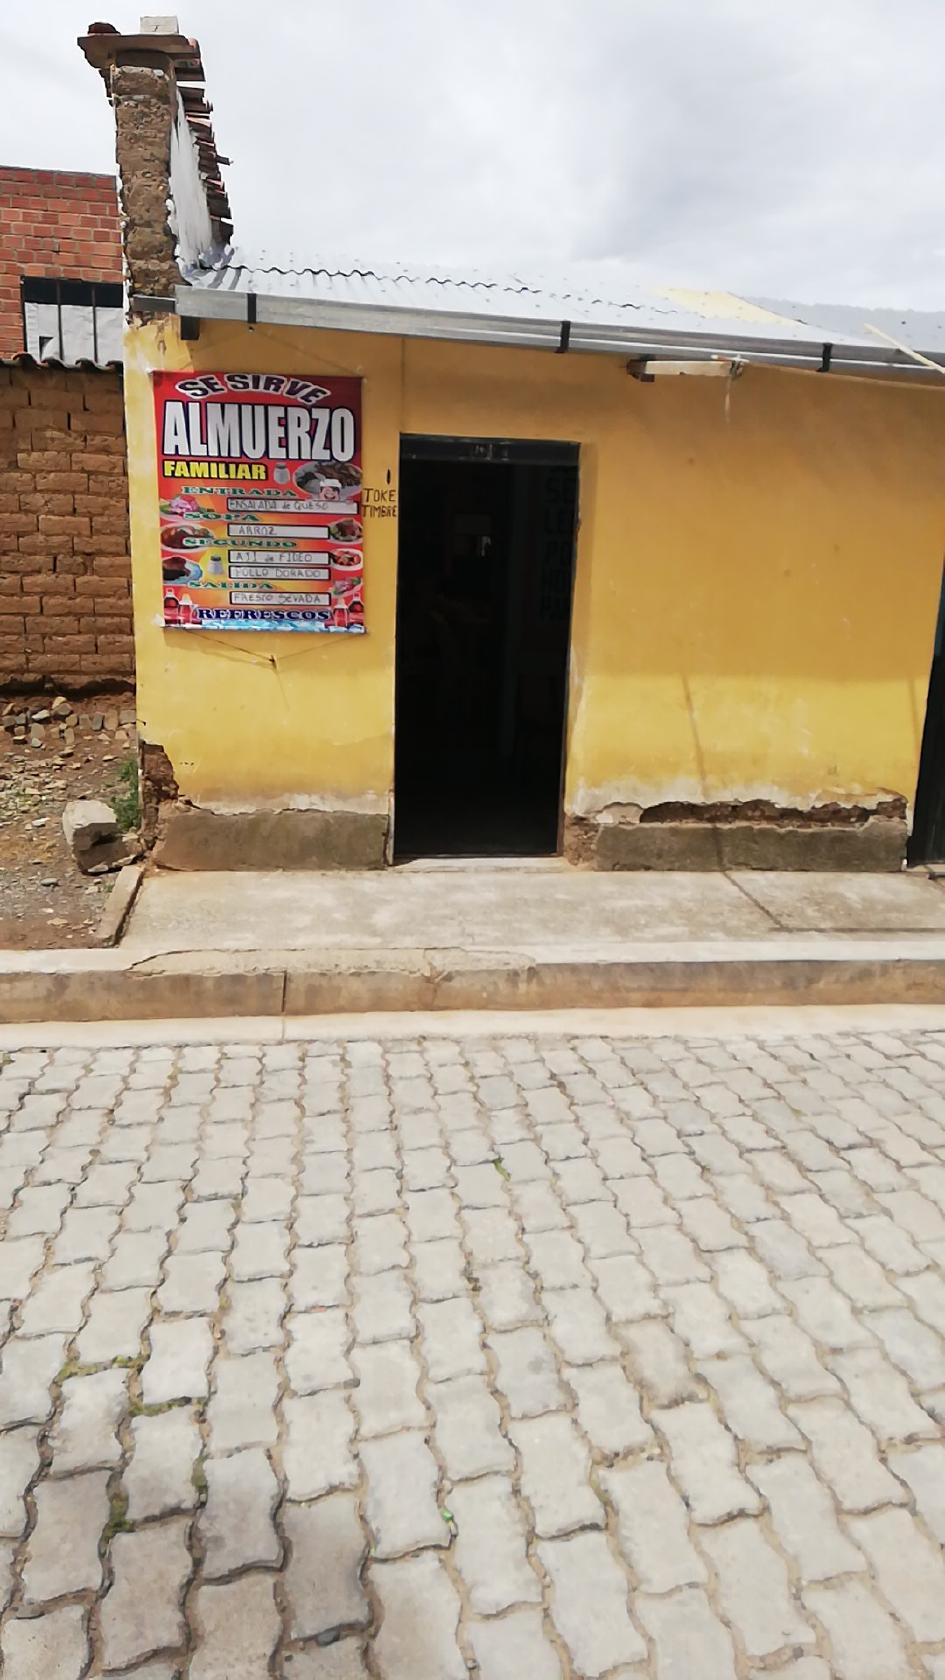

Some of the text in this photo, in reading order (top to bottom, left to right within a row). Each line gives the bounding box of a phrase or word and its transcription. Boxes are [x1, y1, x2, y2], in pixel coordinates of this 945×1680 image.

[177, 374, 330, 404] SE SIRVE
[163, 400, 355, 461] ALMUERZO
[163, 460, 268, 480] FAMILIAR
[183, 486, 297, 497] ENTRADA
[363, 488, 396, 502] TOKE
[185, 511, 260, 521] SOPA
[362, 504, 397, 518] TIMBRE
[239, 526, 277, 536] ARROZ
[184, 537, 297, 548] SEGUNDO
[235, 568, 321, 578] POLLO DORADO
[199, 608, 331, 620] REFRESCOS
